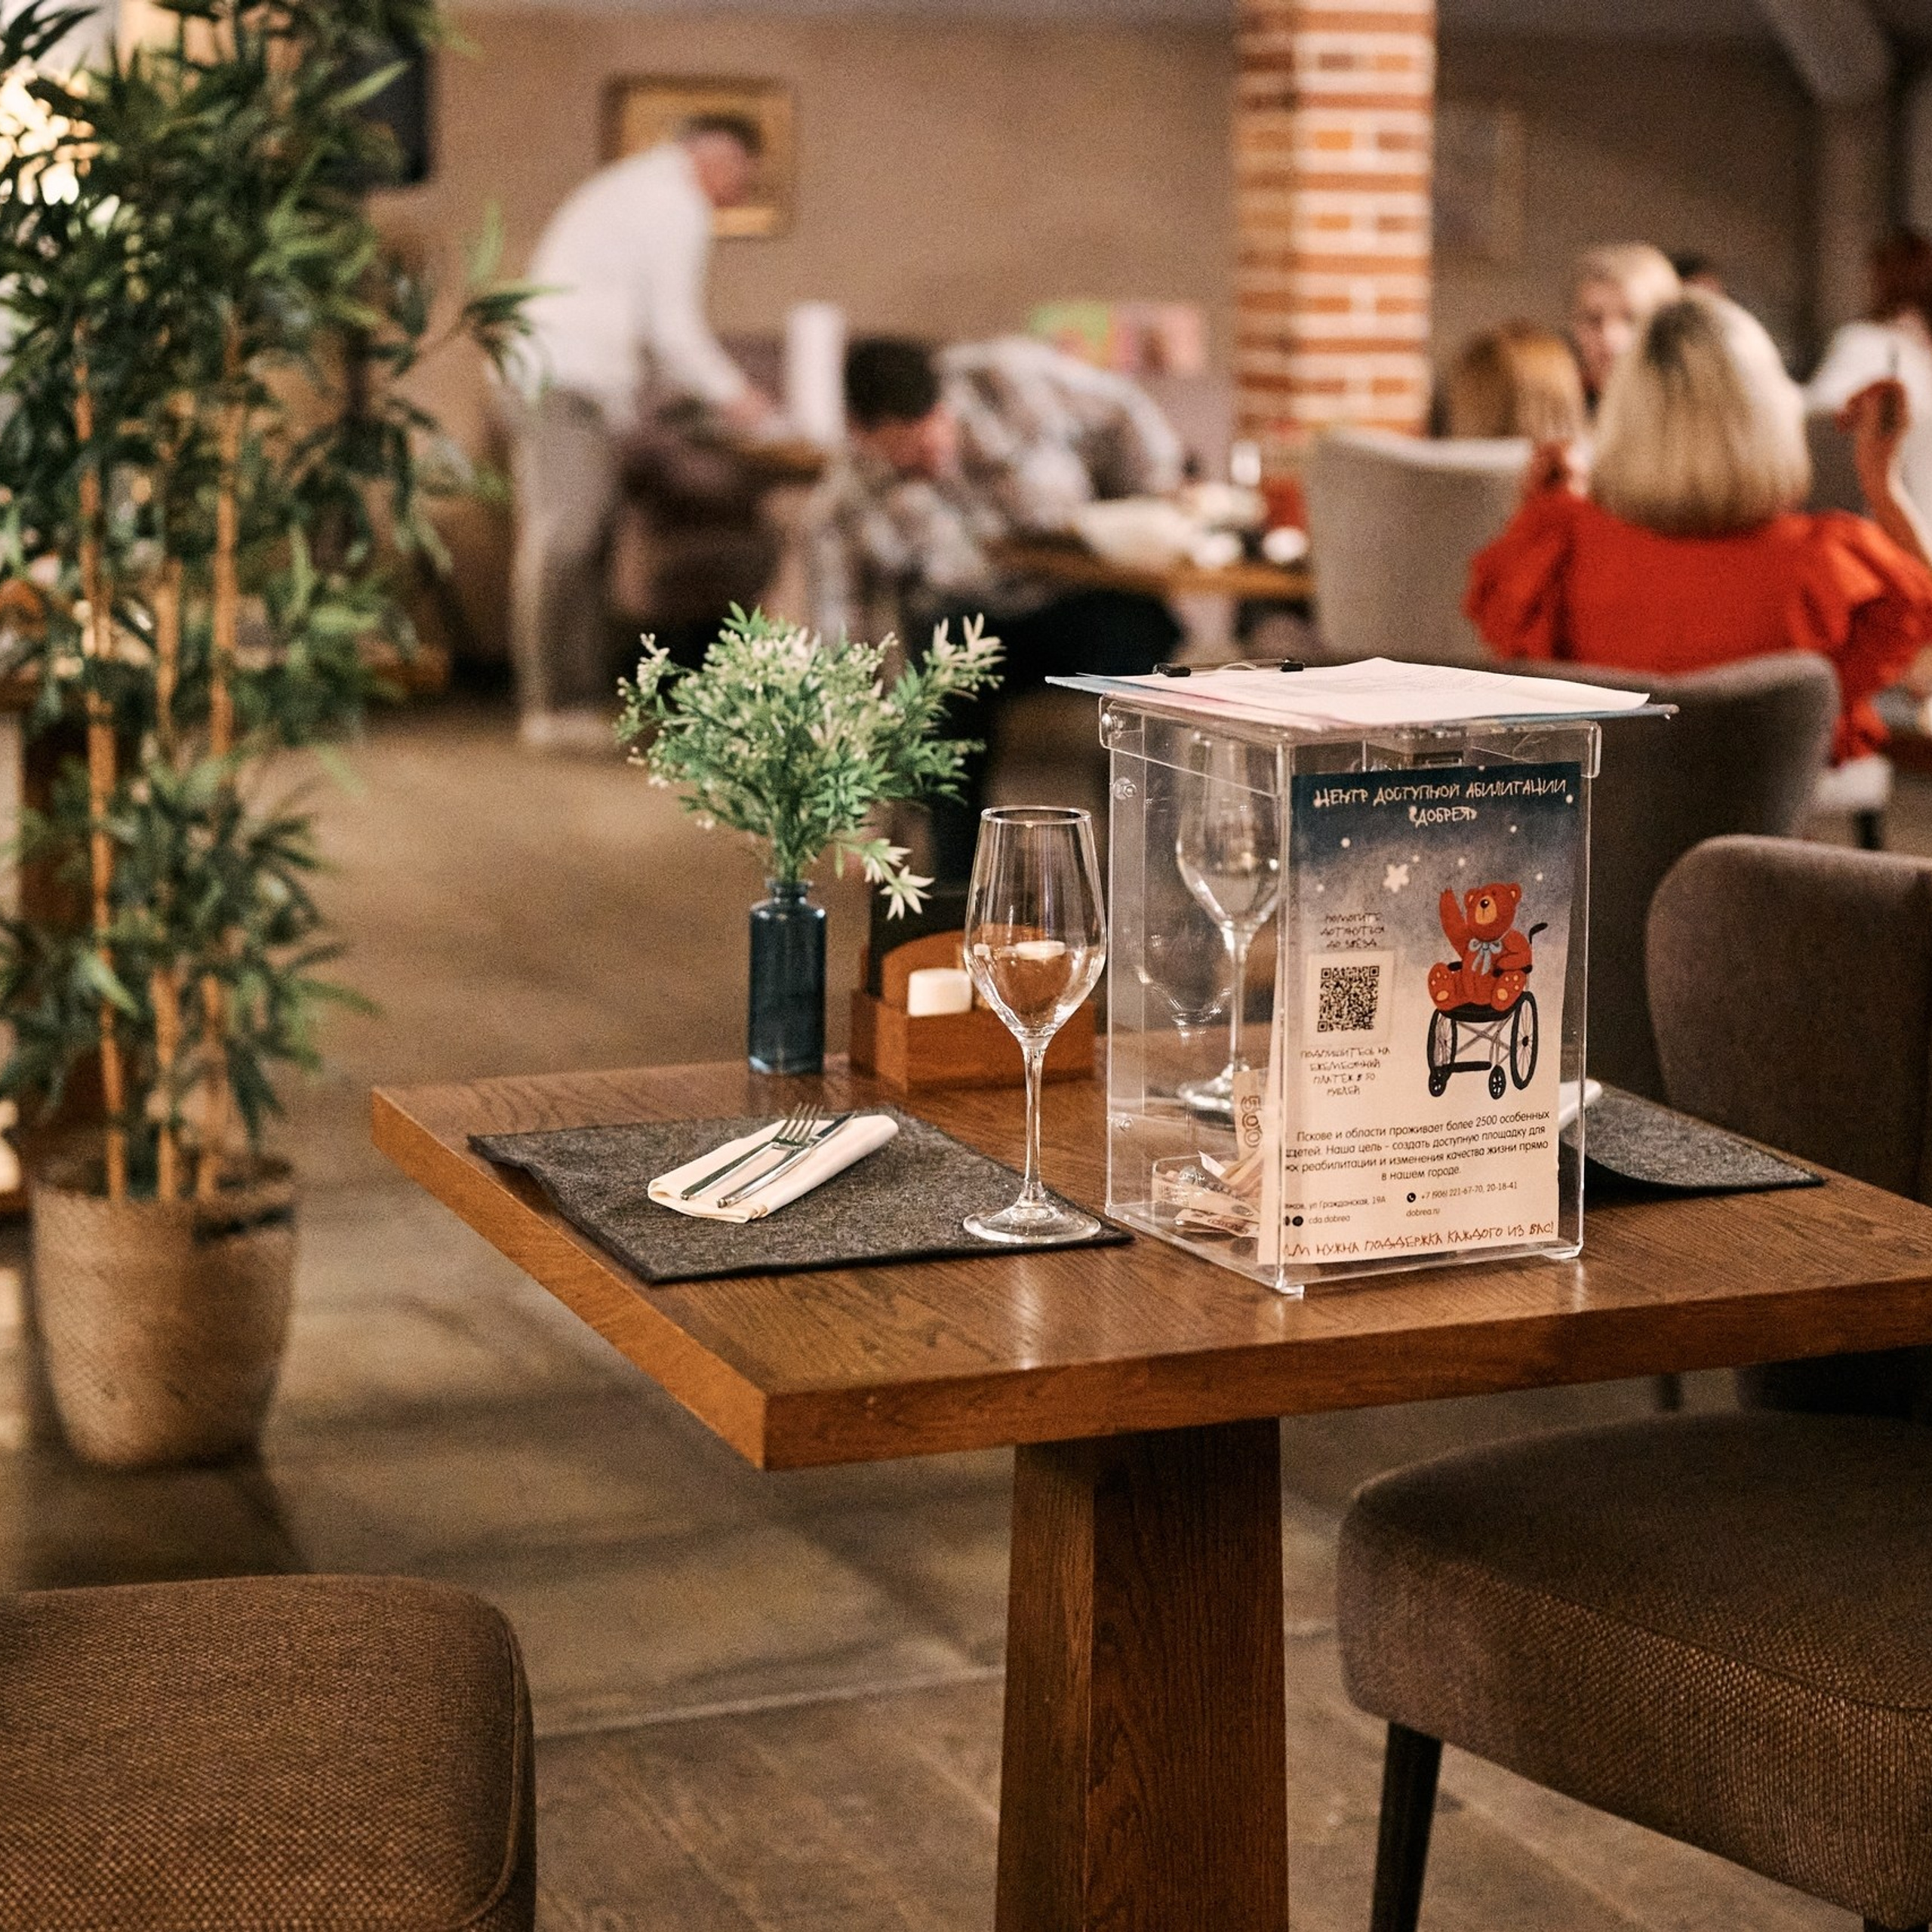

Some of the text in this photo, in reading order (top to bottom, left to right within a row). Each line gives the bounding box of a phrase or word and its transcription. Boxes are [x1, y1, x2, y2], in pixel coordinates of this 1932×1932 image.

[1314, 777, 1566, 807] ЦЕНТР ДОСТУПНОЙ АБИЛИТАЦИИ
[1297, 1131, 1333, 1143] Пскове
[1346, 1127, 1386, 1139] области
[1389, 1124, 1444, 1137] проживает
[1446, 1120, 1473, 1132] более
[1476, 1114, 1497, 1128] 2500
[1500, 1111, 1550, 1124] особенных
[1326, 1145, 1355, 1155] Наша
[1358, 1142, 1383, 1154] цель
[1392, 1138, 1430, 1150] создать
[1432, 1134, 1480, 1149] доступную
[1481, 1127, 1527, 1142] площадку
[1528, 1125, 1546, 1136] для
[1301, 1159, 1377, 1174] реабилитации
[1380, 1158, 1387, 1166] и
[1389, 1152, 1444, 1165] изменения
[1446, 1146, 1484, 1161] качества
[1486, 1143, 1518, 1155] жизни
[1519, 1140, 1549, 1153] прямо
[1381, 1165, 1462, 1181] в нашем городе.
[1486, 1181, 1518, 1193] 20-18-41
[1316, 1242, 1360, 1256] НУЖНА
[1364, 1233, 1443, 1251] ПОДДЕРЖКА
[1447, 1227, 1503, 1243] КАЖДОГО
[1508, 1224, 1524, 1238] ИЗ
[1529, 1221, 1555, 1236] ВАС!
